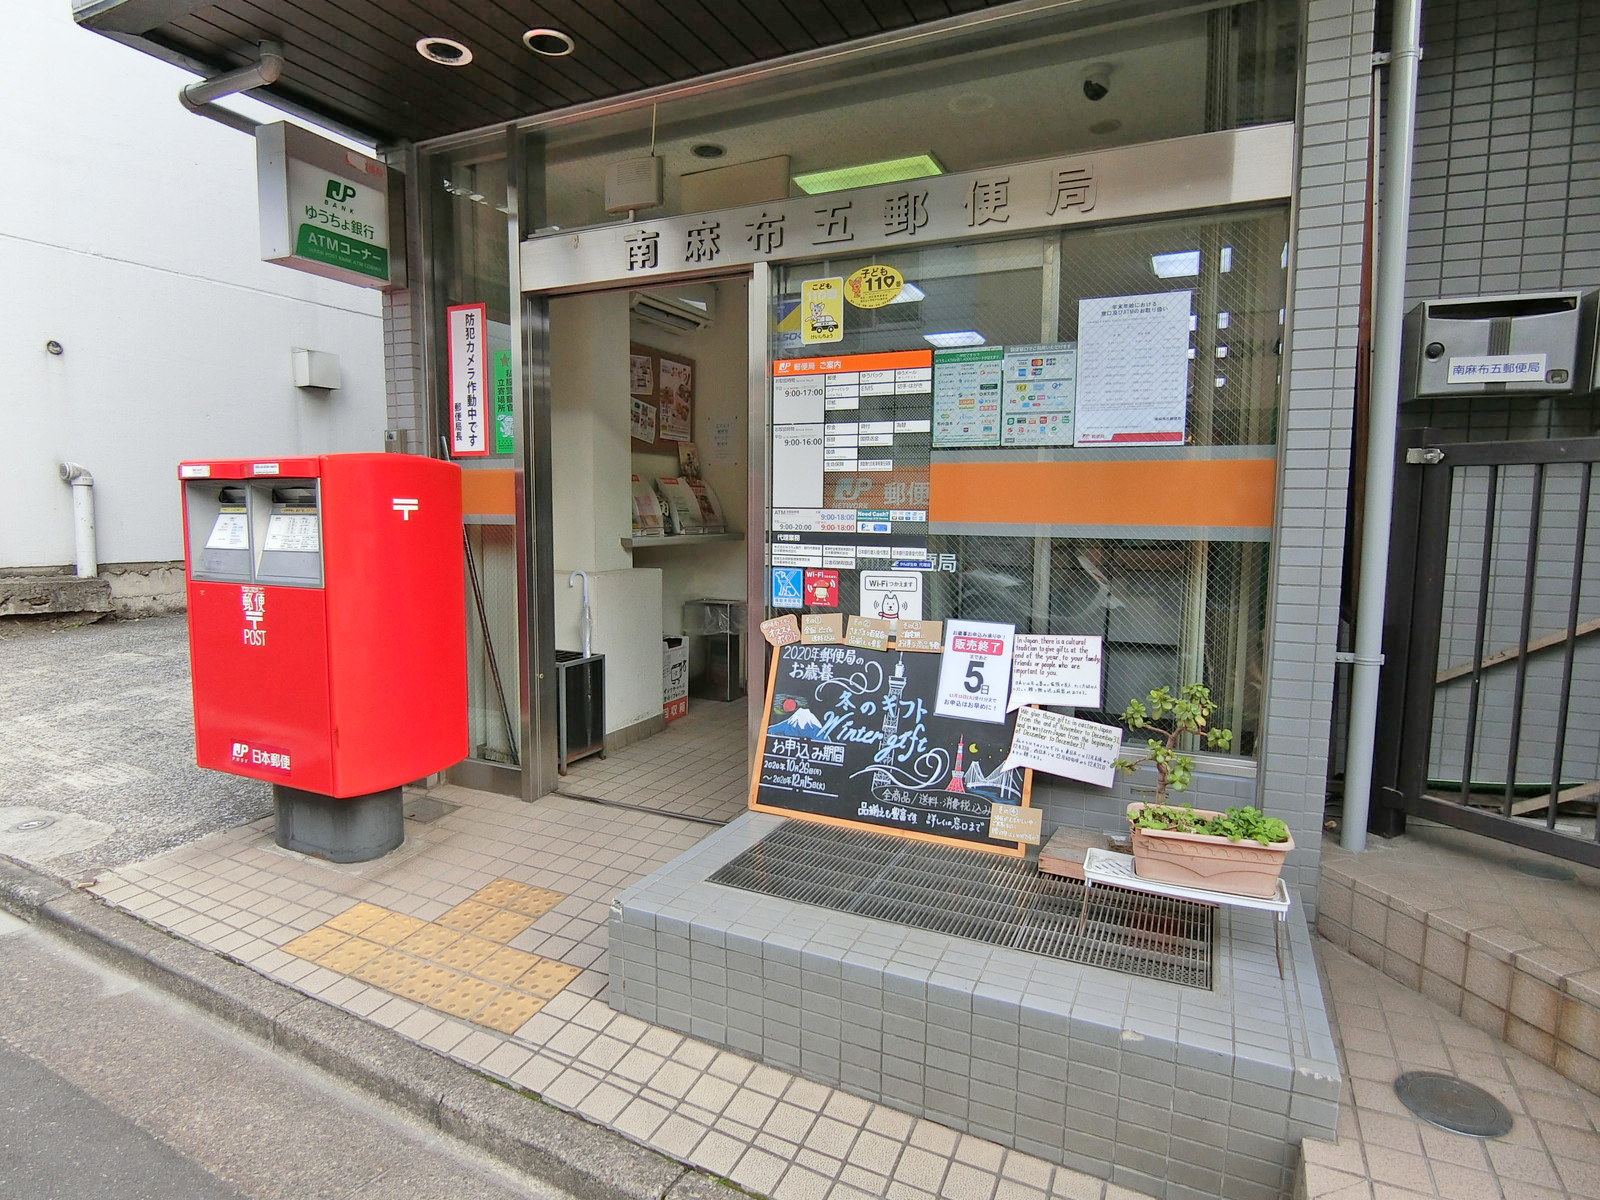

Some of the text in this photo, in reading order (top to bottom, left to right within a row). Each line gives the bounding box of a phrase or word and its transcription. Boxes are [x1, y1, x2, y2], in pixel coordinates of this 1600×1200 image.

[326, 180, 356, 202] JP
[324, 200, 354, 214] BANK
[306, 205, 374, 240] ゆうちょ銀行
[624, 165, 1099, 271] 南麻布五郵便局
[308, 232, 381, 260] ATMコーナー
[861, 267, 888, 278] 子ども
[812, 282, 832, 291] こども
[794, 362, 815, 371] 郵便局
[820, 360, 842, 369] ご案内
[1453, 362, 1540, 376] 南麻布五郵便局
[465, 313, 478, 447] 防犯カメラ作動中です
[785, 389, 823, 397] 9:00-17:00
[242, 593, 266, 612] 郵便
[244, 629, 267, 646] POST
[769, 625, 791, 638] オススメ
[777, 632, 797, 644] ポイント
[954, 639, 1000, 653] 販売終了
[1056, 646, 1069, 654] gifts
[783, 646, 864, 665] 2020年郵便局の
[789, 662, 833, 680] お歳暮
[1014, 668, 1037, 678] important
[835, 691, 928, 724] 冬のギフト
[944, 699, 996, 711] お申込はお早めに！
[1019, 715, 1032, 723] from
[1060, 724, 1083, 734] November
[1091, 731, 1113, 741] December
[1030, 711, 1040, 719] give
[1057, 716, 1070, 725] gifts
[1078, 722, 1097, 730] eastern
[1098, 725, 1112, 735] Japan
[816, 711, 928, 762] Winter gift
[1022, 729, 1046, 740] December
[1055, 736, 1079, 747] December
[1032, 726, 1051, 734] western
[1052, 729, 1066, 739] Japan
[1067, 732, 1080, 740] from
[1091, 738, 1114, 750] beginning
[232, 743, 291, 770] JP 日本郵便
[772, 738, 845, 763] お申込み期間
[764, 759, 822, 775] 2020年10月26日(月)
[926, 813, 984, 832] 詳しくは窓口まで
